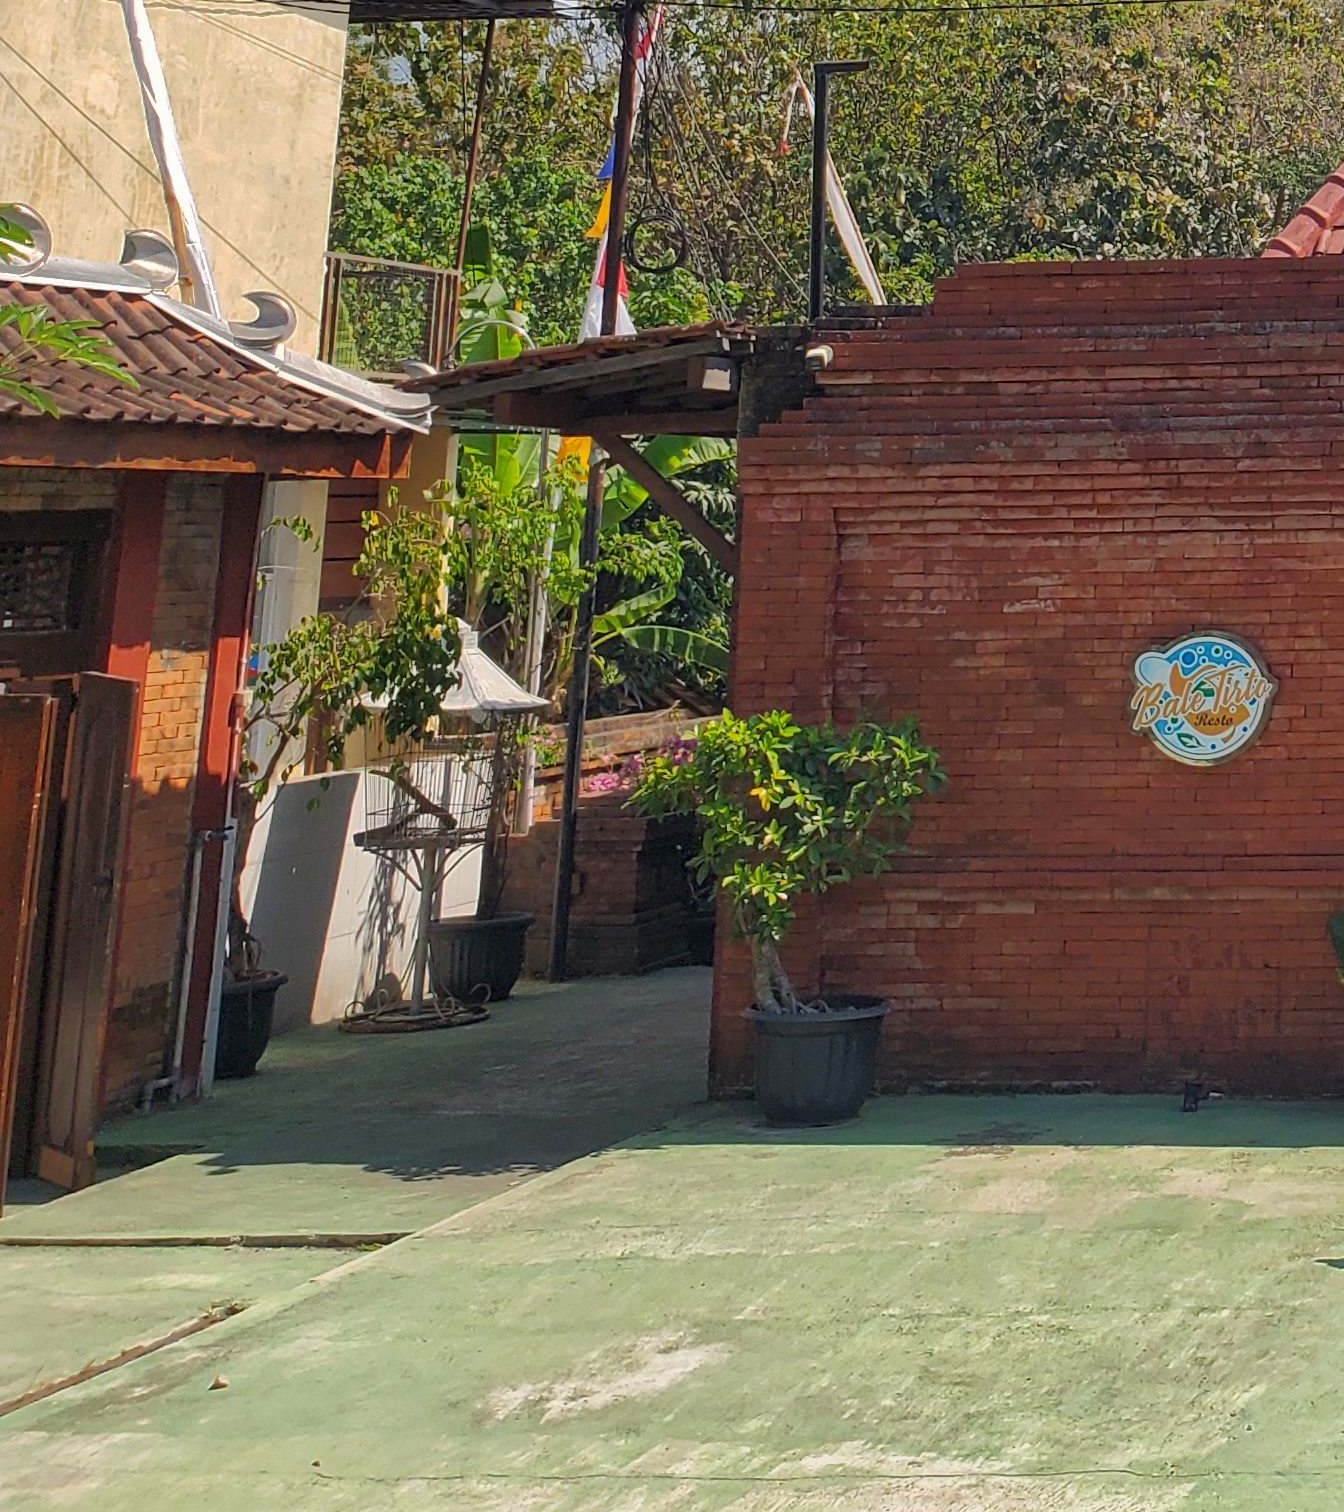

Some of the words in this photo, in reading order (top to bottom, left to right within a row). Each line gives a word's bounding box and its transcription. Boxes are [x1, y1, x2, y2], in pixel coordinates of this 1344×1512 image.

[1131, 681, 1207, 730] Bale
[1205, 665, 1272, 713] Tirto
[1194, 712, 1234, 726] Resto
